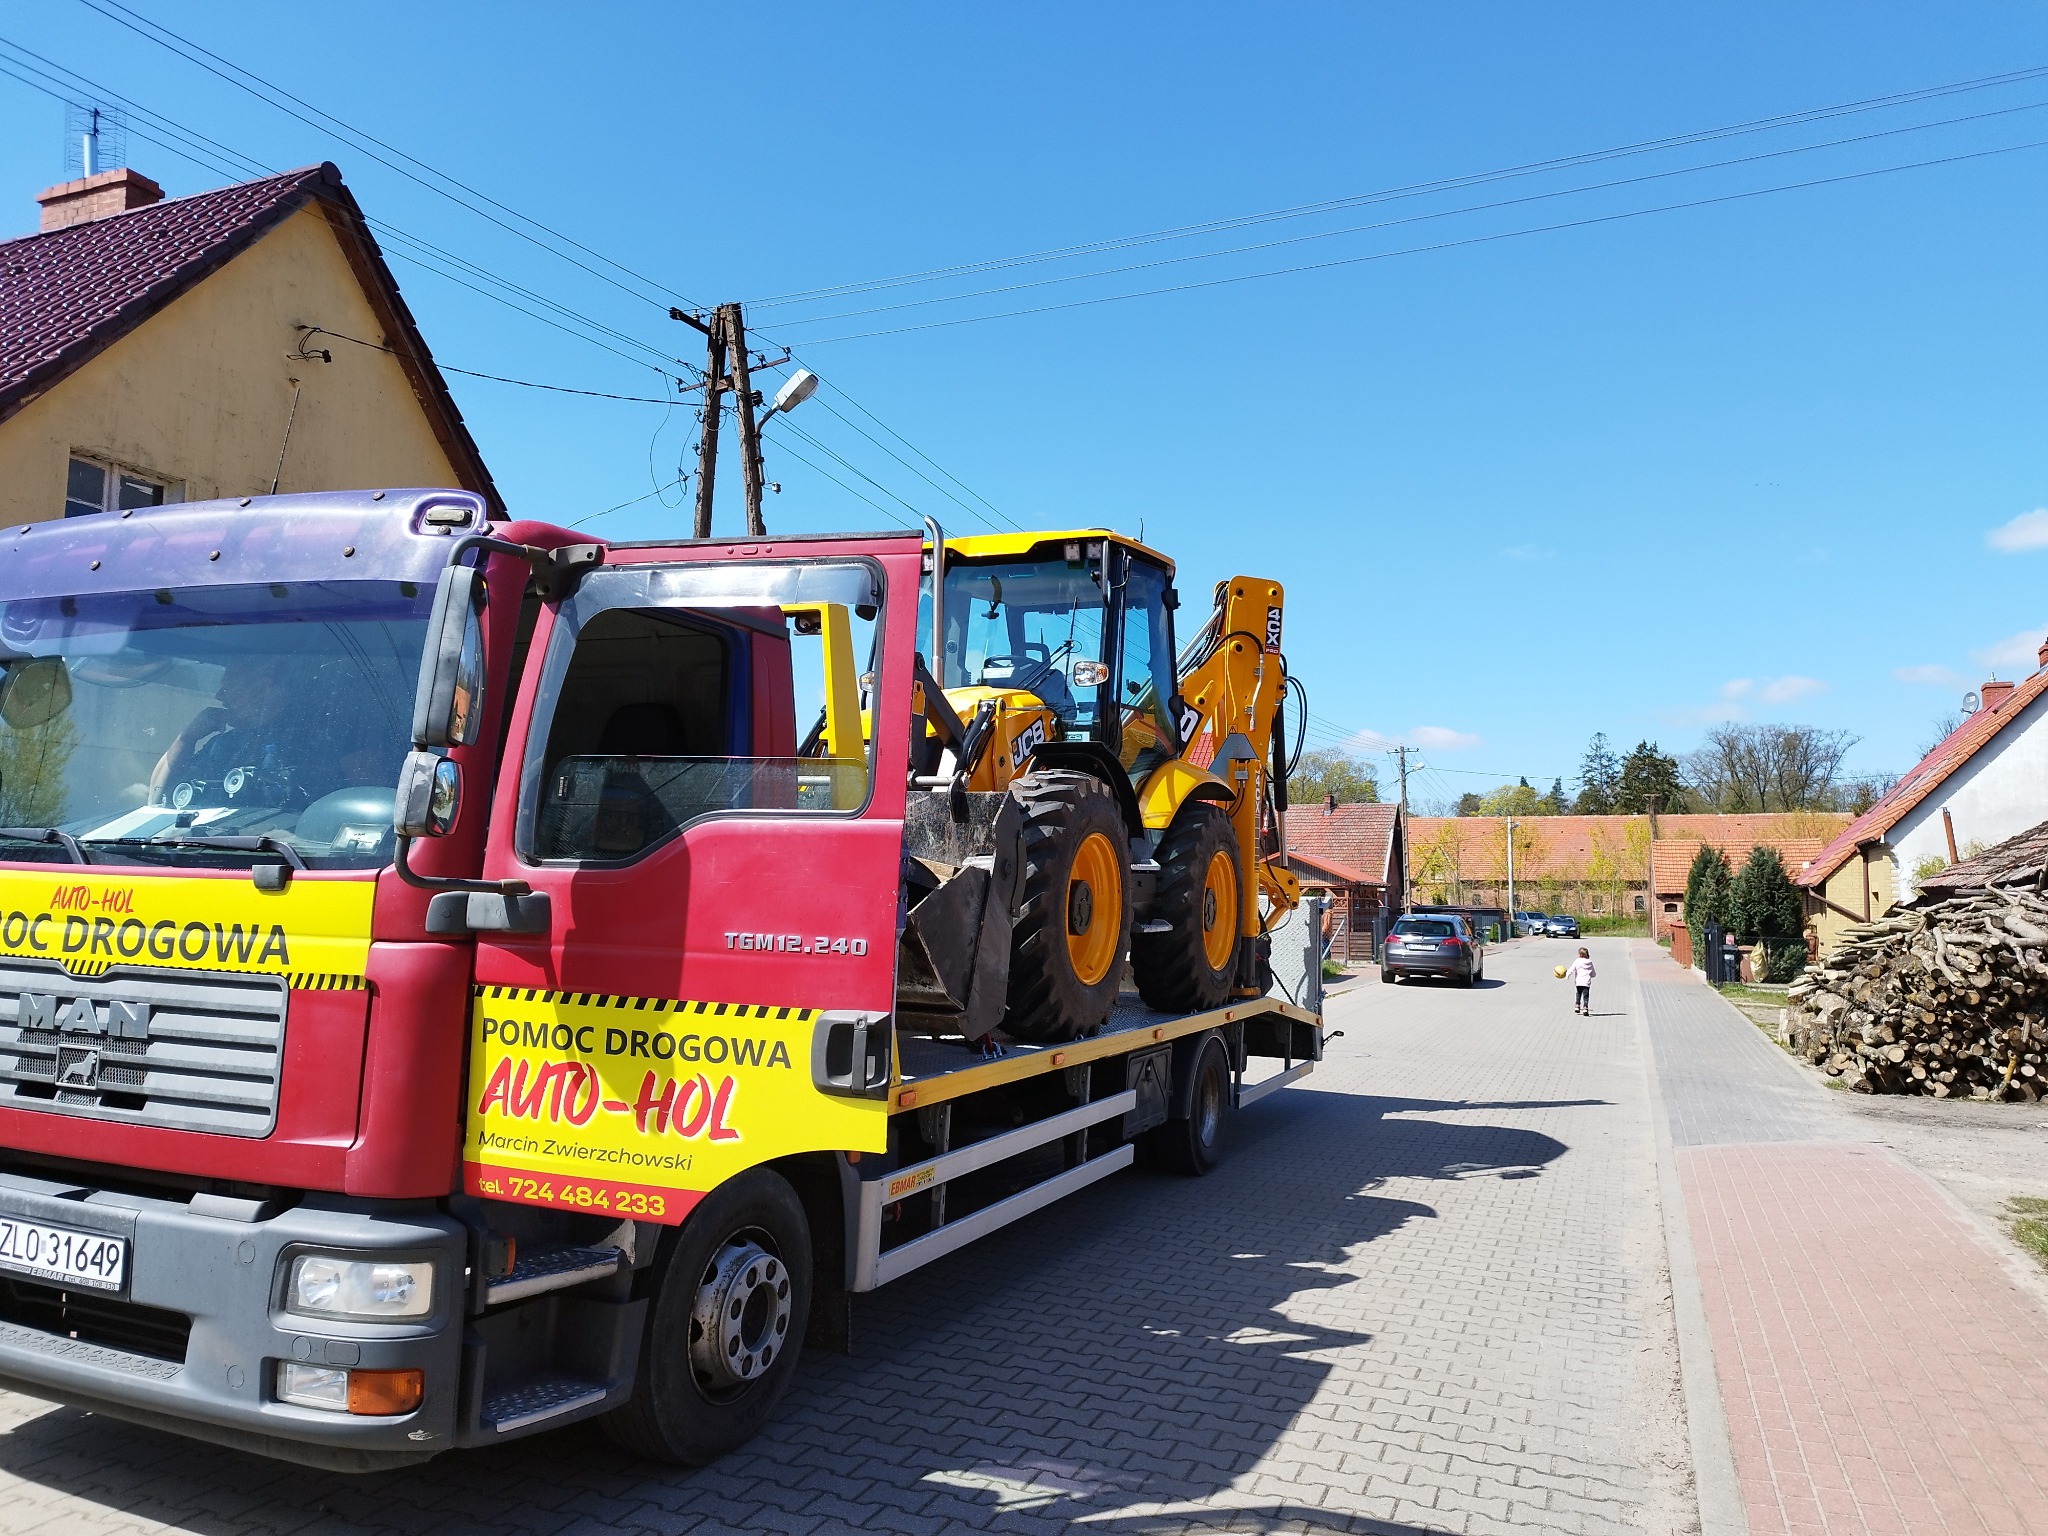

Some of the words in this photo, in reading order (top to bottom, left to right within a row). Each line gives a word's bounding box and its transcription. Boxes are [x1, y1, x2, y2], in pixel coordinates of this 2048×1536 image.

[1267, 609, 1280, 645] 4CX
[1014, 719, 1045, 766] JCB
[49, 885, 134, 914] AUTO-HOL
[0, 911, 52, 950] OC
[61, 914, 291, 966] DROGOWA
[17, 992, 150, 1039] MAN
[482, 1017, 595, 1055] POMOC
[605, 1027, 792, 1070] DROGOWA
[478, 1056, 740, 1141] AUTO-HOL
[478, 1130, 539, 1153] Marcin
[542, 1139, 693, 1171] Zwierzchowski
[478, 1177, 504, 1195] tel.
[508, 1177, 554, 1202] 724
[559, 1184, 610, 1209] 484
[615, 1191, 666, 1216] 233
[891, 1175, 917, 1196] EBMAR
[0, 1222, 39, 1262] ZLO
[46, 1232, 120, 1277] 31649
[31, 1267, 64, 1281] EBMAR
